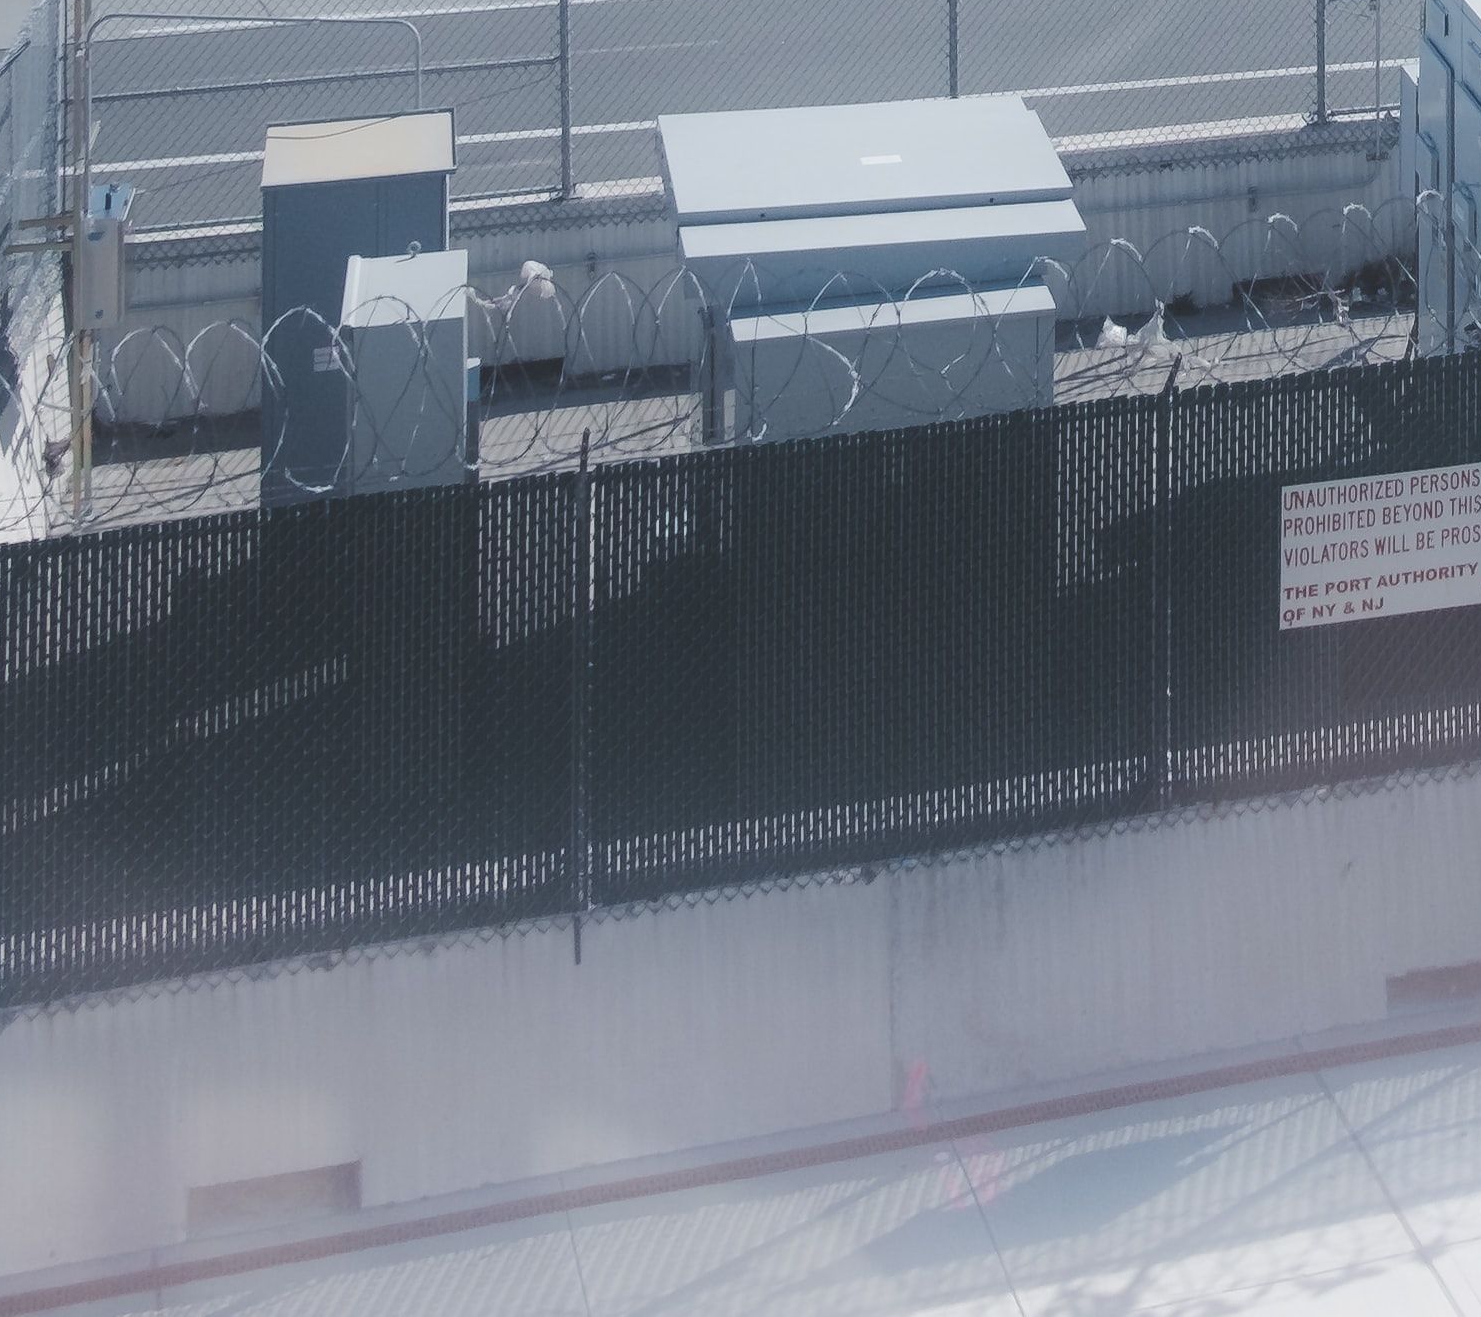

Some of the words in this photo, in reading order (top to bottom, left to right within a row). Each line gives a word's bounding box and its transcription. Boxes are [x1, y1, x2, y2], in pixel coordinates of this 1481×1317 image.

[1283, 479, 1405, 511] UNAUTHORIZED
[1410, 469, 1481, 496] PERSONS
[1283, 508, 1376, 538] PROHIBITED
[1382, 500, 1444, 525] BEYOND
[1284, 539, 1370, 567] VIOLATORS
[1374, 534, 1411, 557] WILL
[1416, 530, 1435, 550] BE
[1284, 585, 1319, 601] THE
[1325, 576, 1372, 596] PORT
[1376, 562, 1479, 590] AUTHORITY
[1282, 607, 1306, 624] OF
[1311, 603, 1336, 620] NY
[1343, 600, 1356, 616] &
[1361, 597, 1385, 613] NJ
